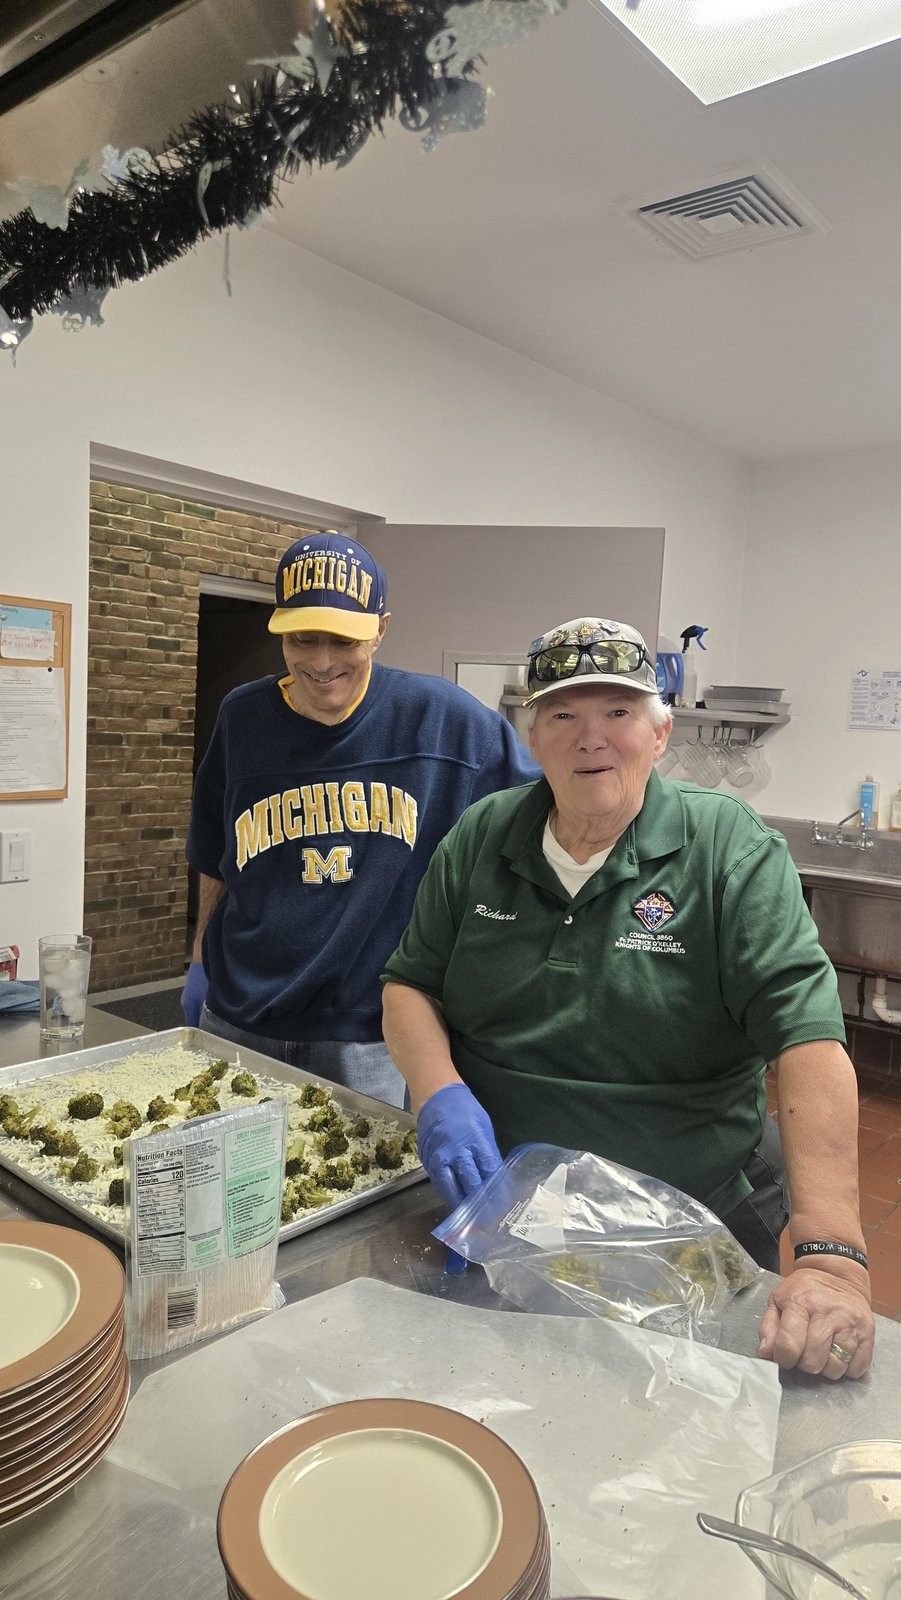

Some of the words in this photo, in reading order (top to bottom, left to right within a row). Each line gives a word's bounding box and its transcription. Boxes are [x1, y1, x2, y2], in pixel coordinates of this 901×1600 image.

[295, 550, 347, 561] UNIVERSITY
[351, 558, 361, 566] OF
[283, 556, 373, 609] MICHIGAN
[235, 781, 418, 872] MICHIGAN
[302, 846, 353, 884] M
[474, 904, 518, 920] Richard
[630, 932, 656, 940] COUNCIL
[615, 942, 641, 950] KNIGHTS
[627, 938, 651, 946] PATRICK
[138, 1153, 164, 1161] Nutrition
[172, 1171, 184, 1179] 120
[803, 1243, 834, 1251] WORLD
[838, 1245, 854, 1255] THE
